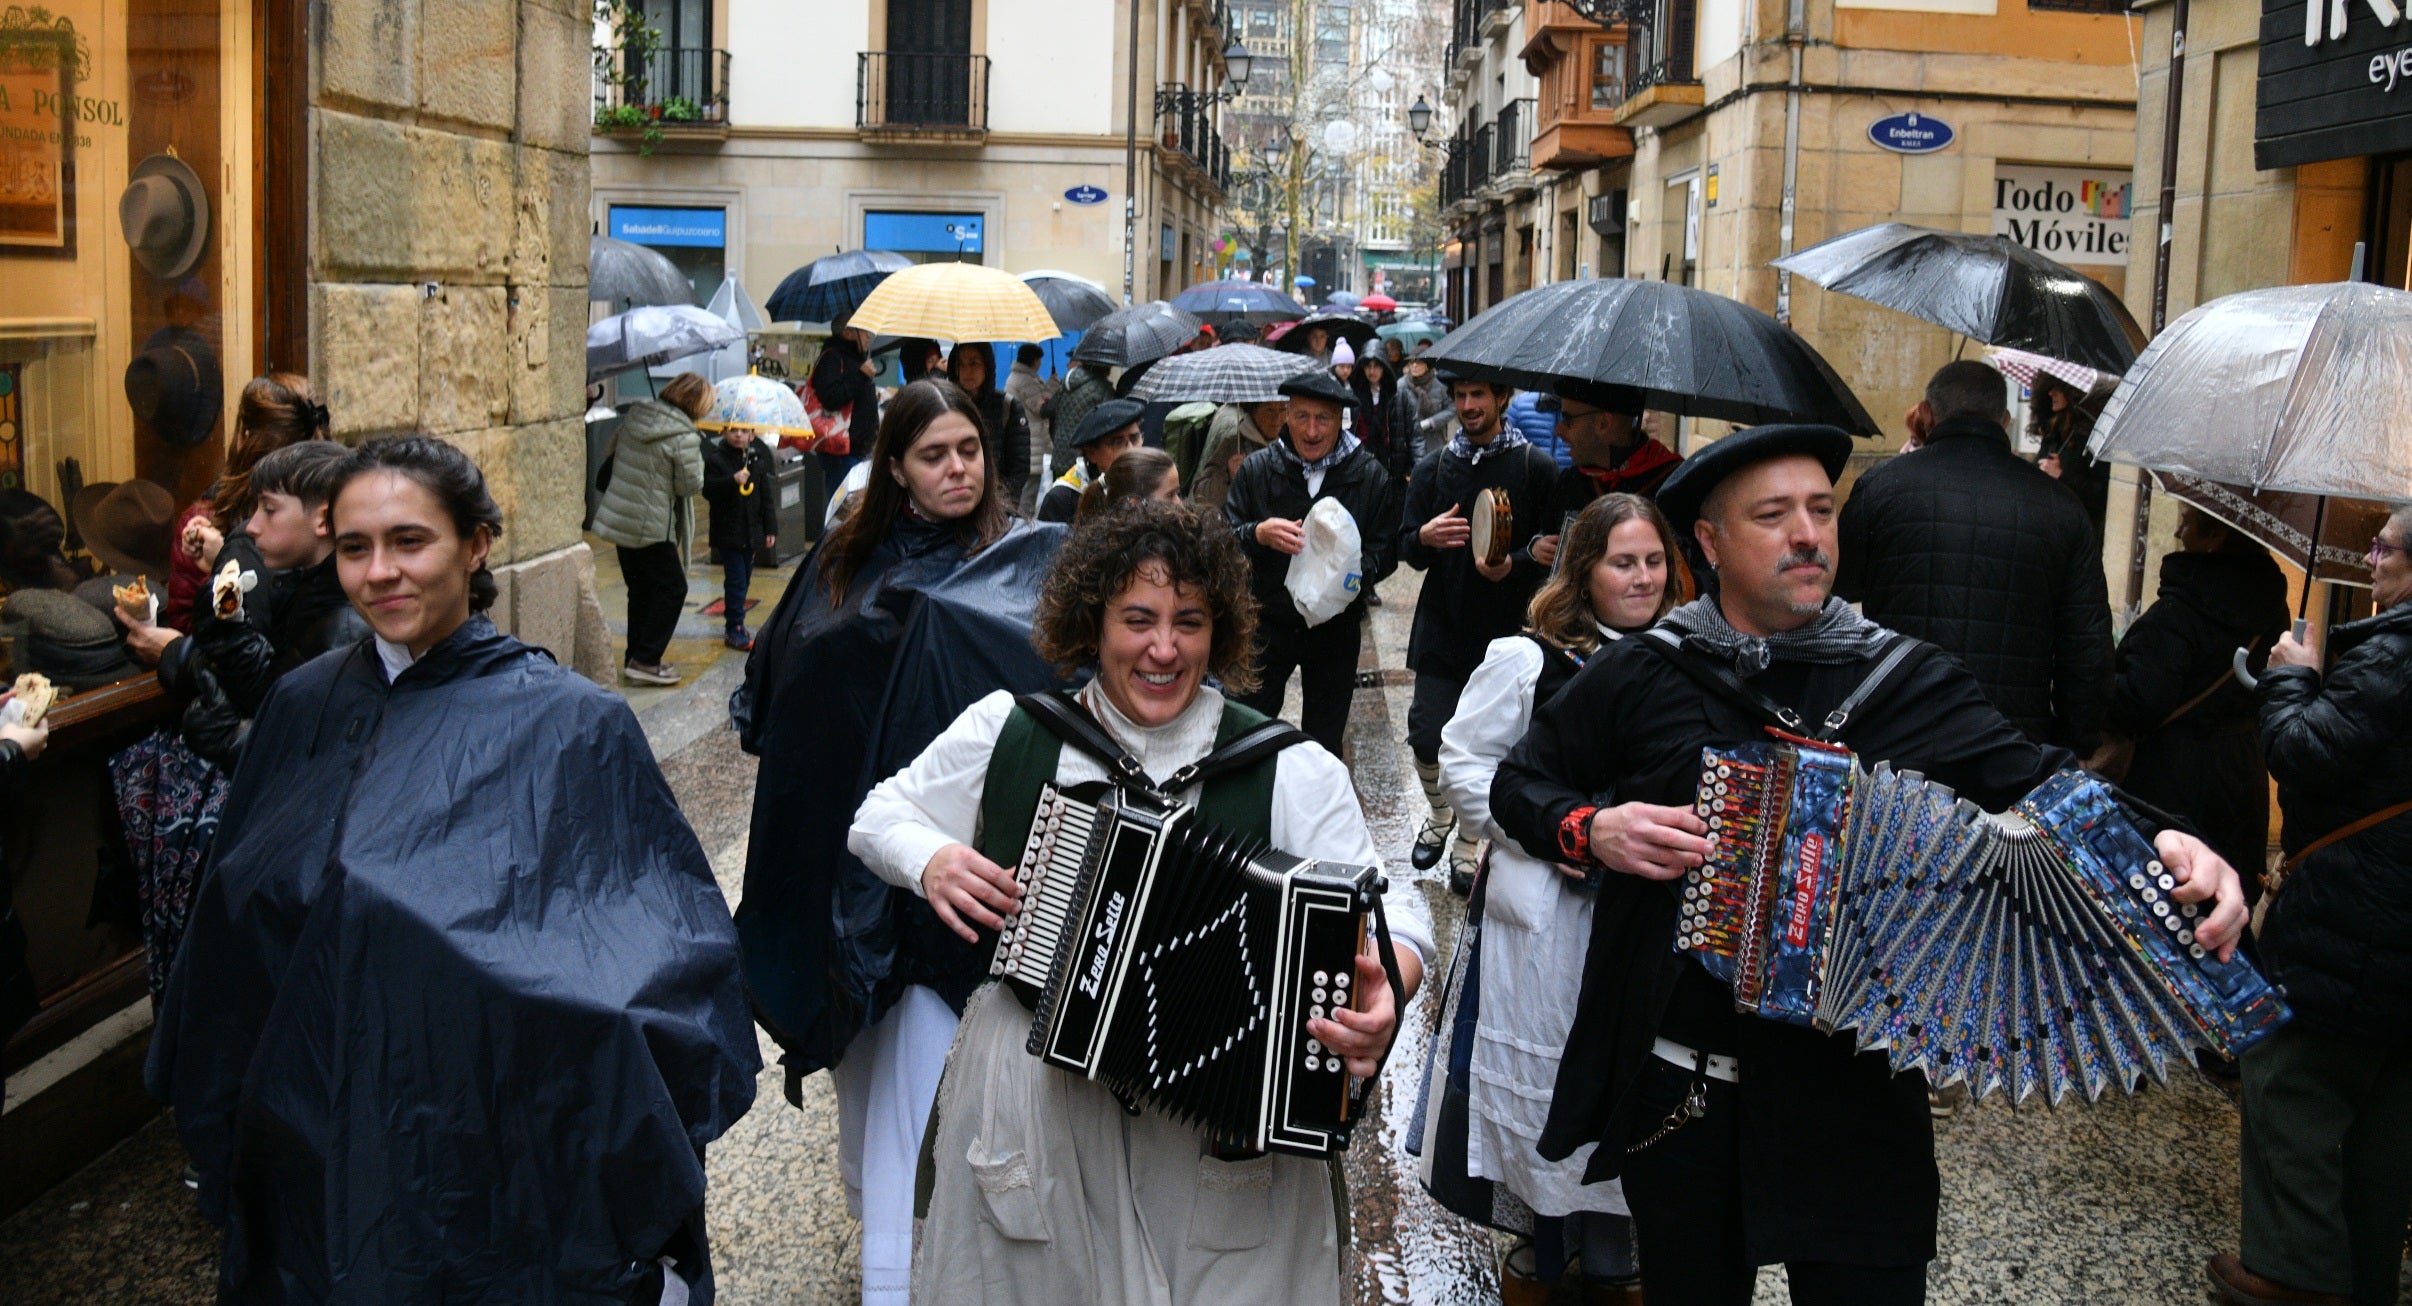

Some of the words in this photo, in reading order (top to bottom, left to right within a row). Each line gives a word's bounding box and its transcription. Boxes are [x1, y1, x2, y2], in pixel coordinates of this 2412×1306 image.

[33, 88, 122, 126] PONSOL
[1889, 127, 1934, 140] Enbeltran
[1994, 177, 2075, 213] Todo
[1796, 838, 1818, 890] Sette
[1095, 890, 1125, 945] Sette
